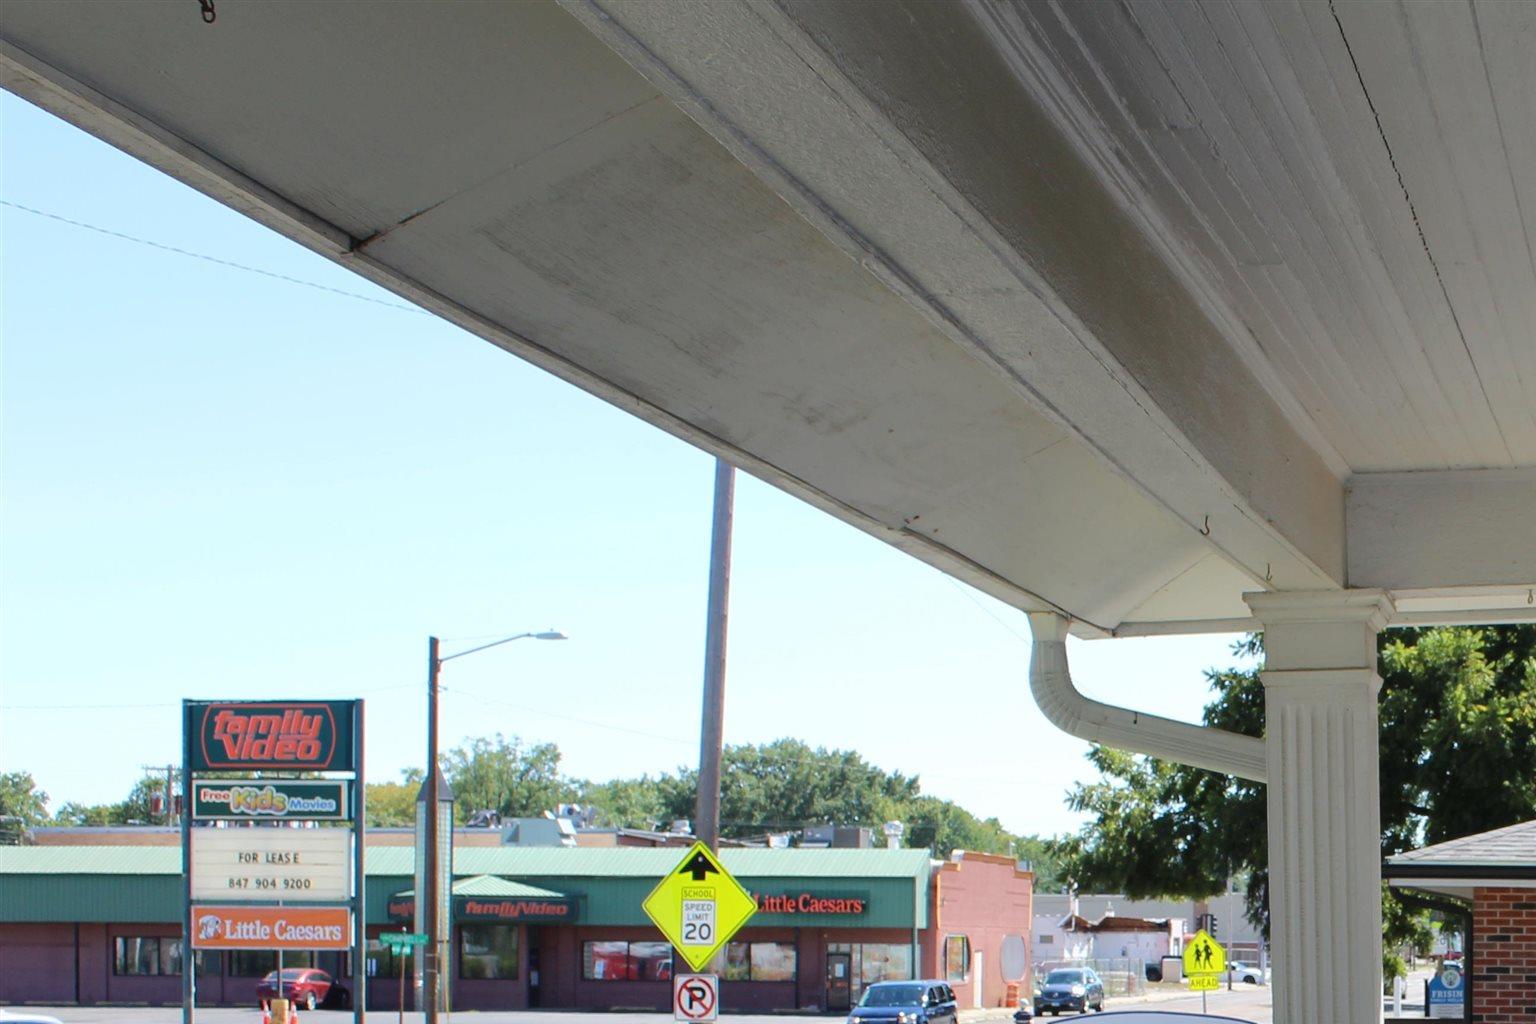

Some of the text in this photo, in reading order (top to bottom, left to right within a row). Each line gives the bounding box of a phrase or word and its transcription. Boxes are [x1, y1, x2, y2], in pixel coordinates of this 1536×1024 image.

[222, 735, 321, 760] Video
[202, 786, 335, 814] Free Kids Movies
[239, 852, 300, 864] FOR LEASE
[228, 878, 312, 889] 847 904 9200
[683, 889, 714, 898] SCHOOL
[684, 903, 713, 912] SPEED
[754, 893, 863, 913] Little Caesars
[687, 913, 709, 921] LIMIT
[224, 919, 342, 940] Little Caesars
[684, 923, 712, 940] 20
[1190, 978, 1217, 988] AHEAD
